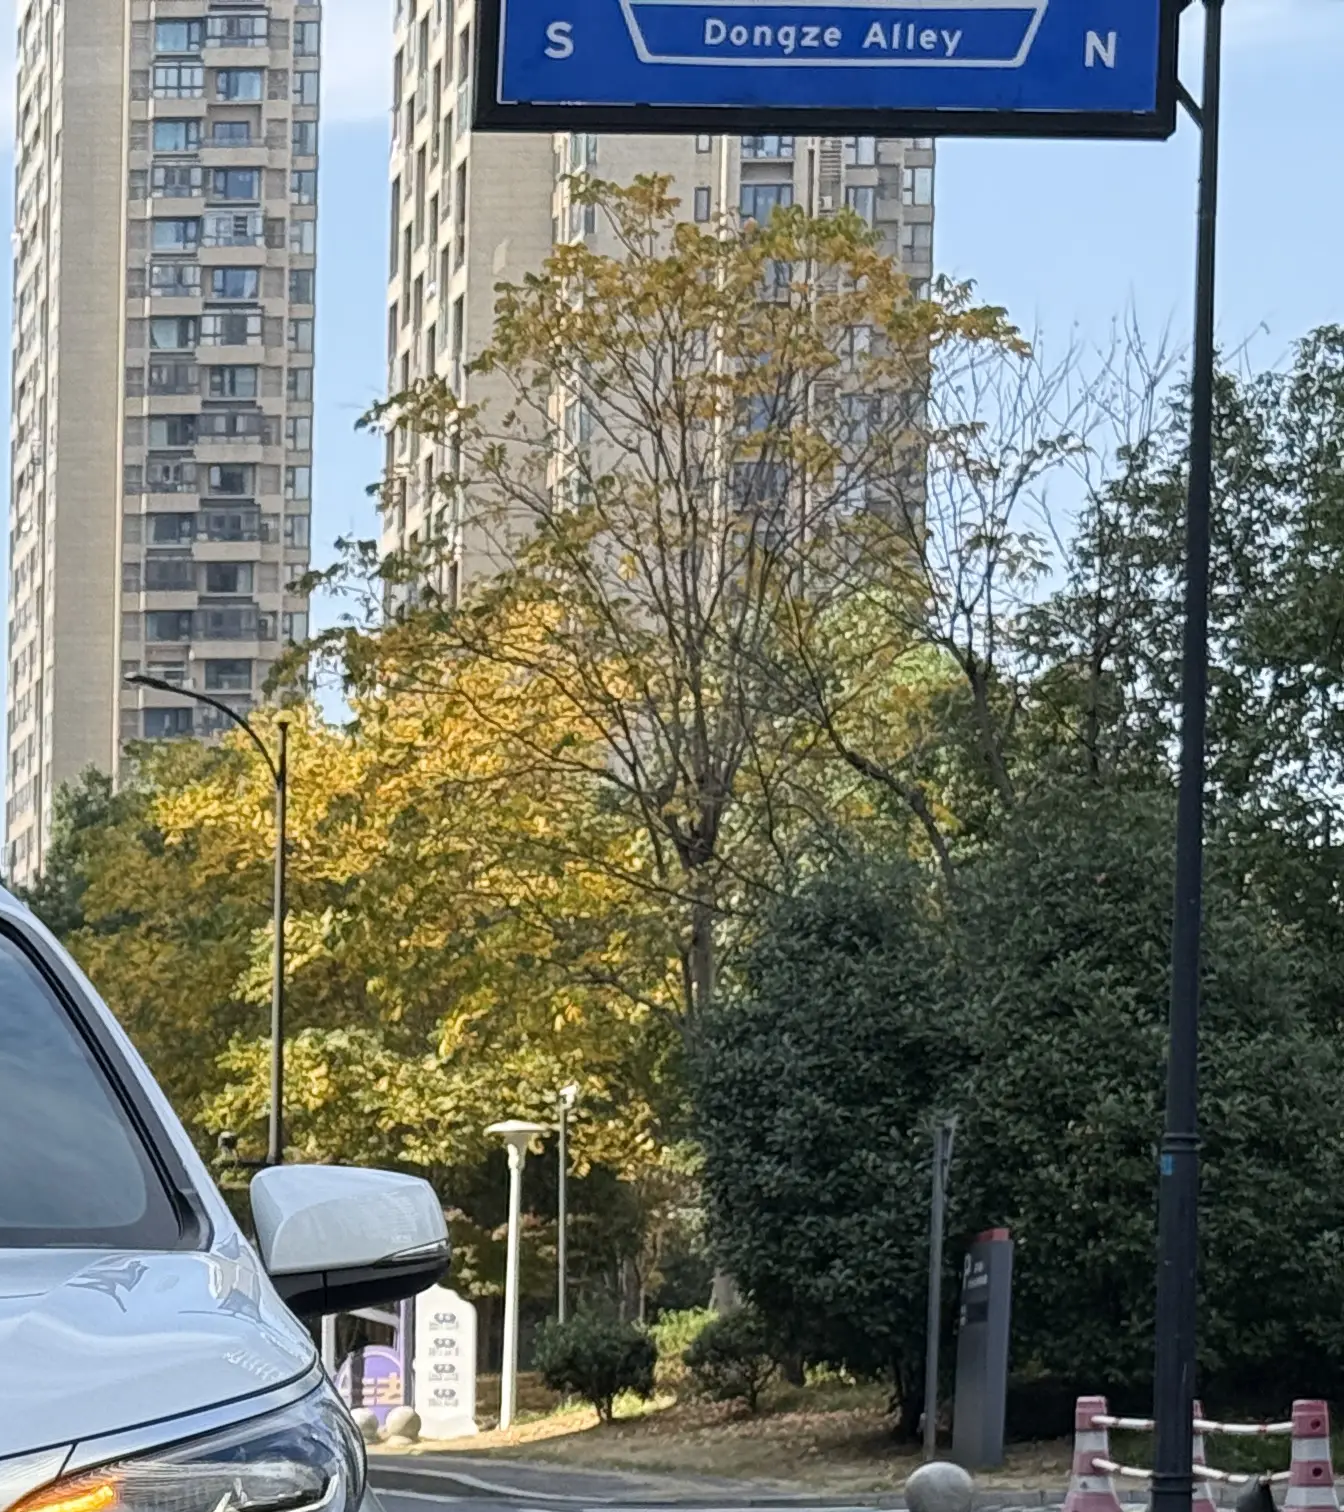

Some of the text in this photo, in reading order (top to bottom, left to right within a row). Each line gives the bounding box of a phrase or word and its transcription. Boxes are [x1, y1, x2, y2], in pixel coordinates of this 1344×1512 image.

[544, 21, 574, 59] S
[704, 18, 962, 57] Dongze Alley
[1085, 30, 1117, 69] N
